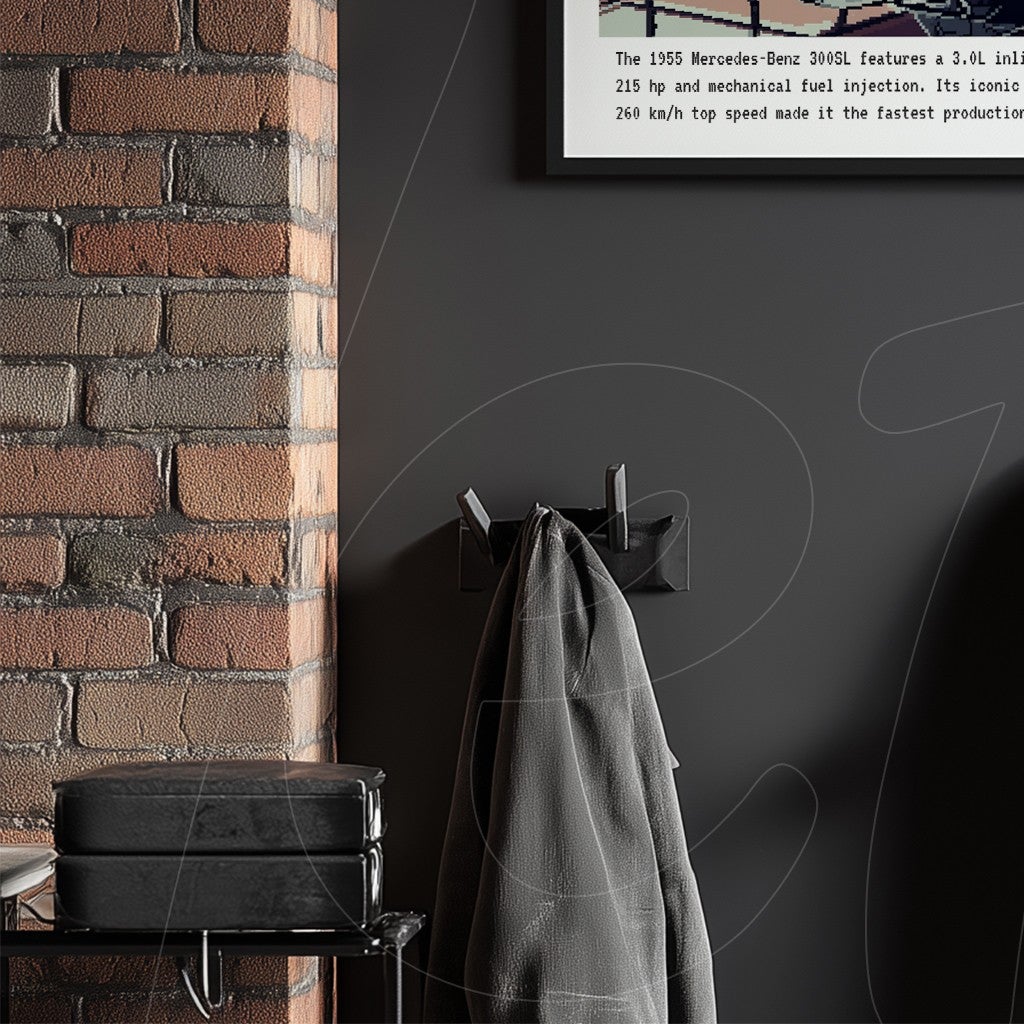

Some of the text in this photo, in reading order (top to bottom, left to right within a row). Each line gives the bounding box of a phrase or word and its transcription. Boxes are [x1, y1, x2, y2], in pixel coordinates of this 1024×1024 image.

[615, 51, 641, 66] The
[649, 51, 683, 66] 1955
[691, 51, 801, 66] Mercedes-Benz
[809, 50, 852, 66] 300SL
[860, 50, 927, 66] features
[935, 54, 944, 66] a
[952, 50, 986, 66] 3.0L
[615, 78, 641, 93] 215
[649, 78, 666, 97] hp
[674, 78, 700, 93] and
[707, 78, 792, 93] mechanical
[801, 78, 834, 93] fuel
[843, 78, 925, 97] injection.
[936, 78, 960, 93] Its
[969, 78, 1020, 93] iconic
[615, 106, 640, 120] 260
[649, 104, 683, 122] km/h
[691, 106, 717, 124] top
[725, 106, 768, 124] speed
[775, 106, 810, 120] made
[818, 105, 834, 120] it
[842, 105, 868, 120] the
[877, 105, 935, 120] fastest
